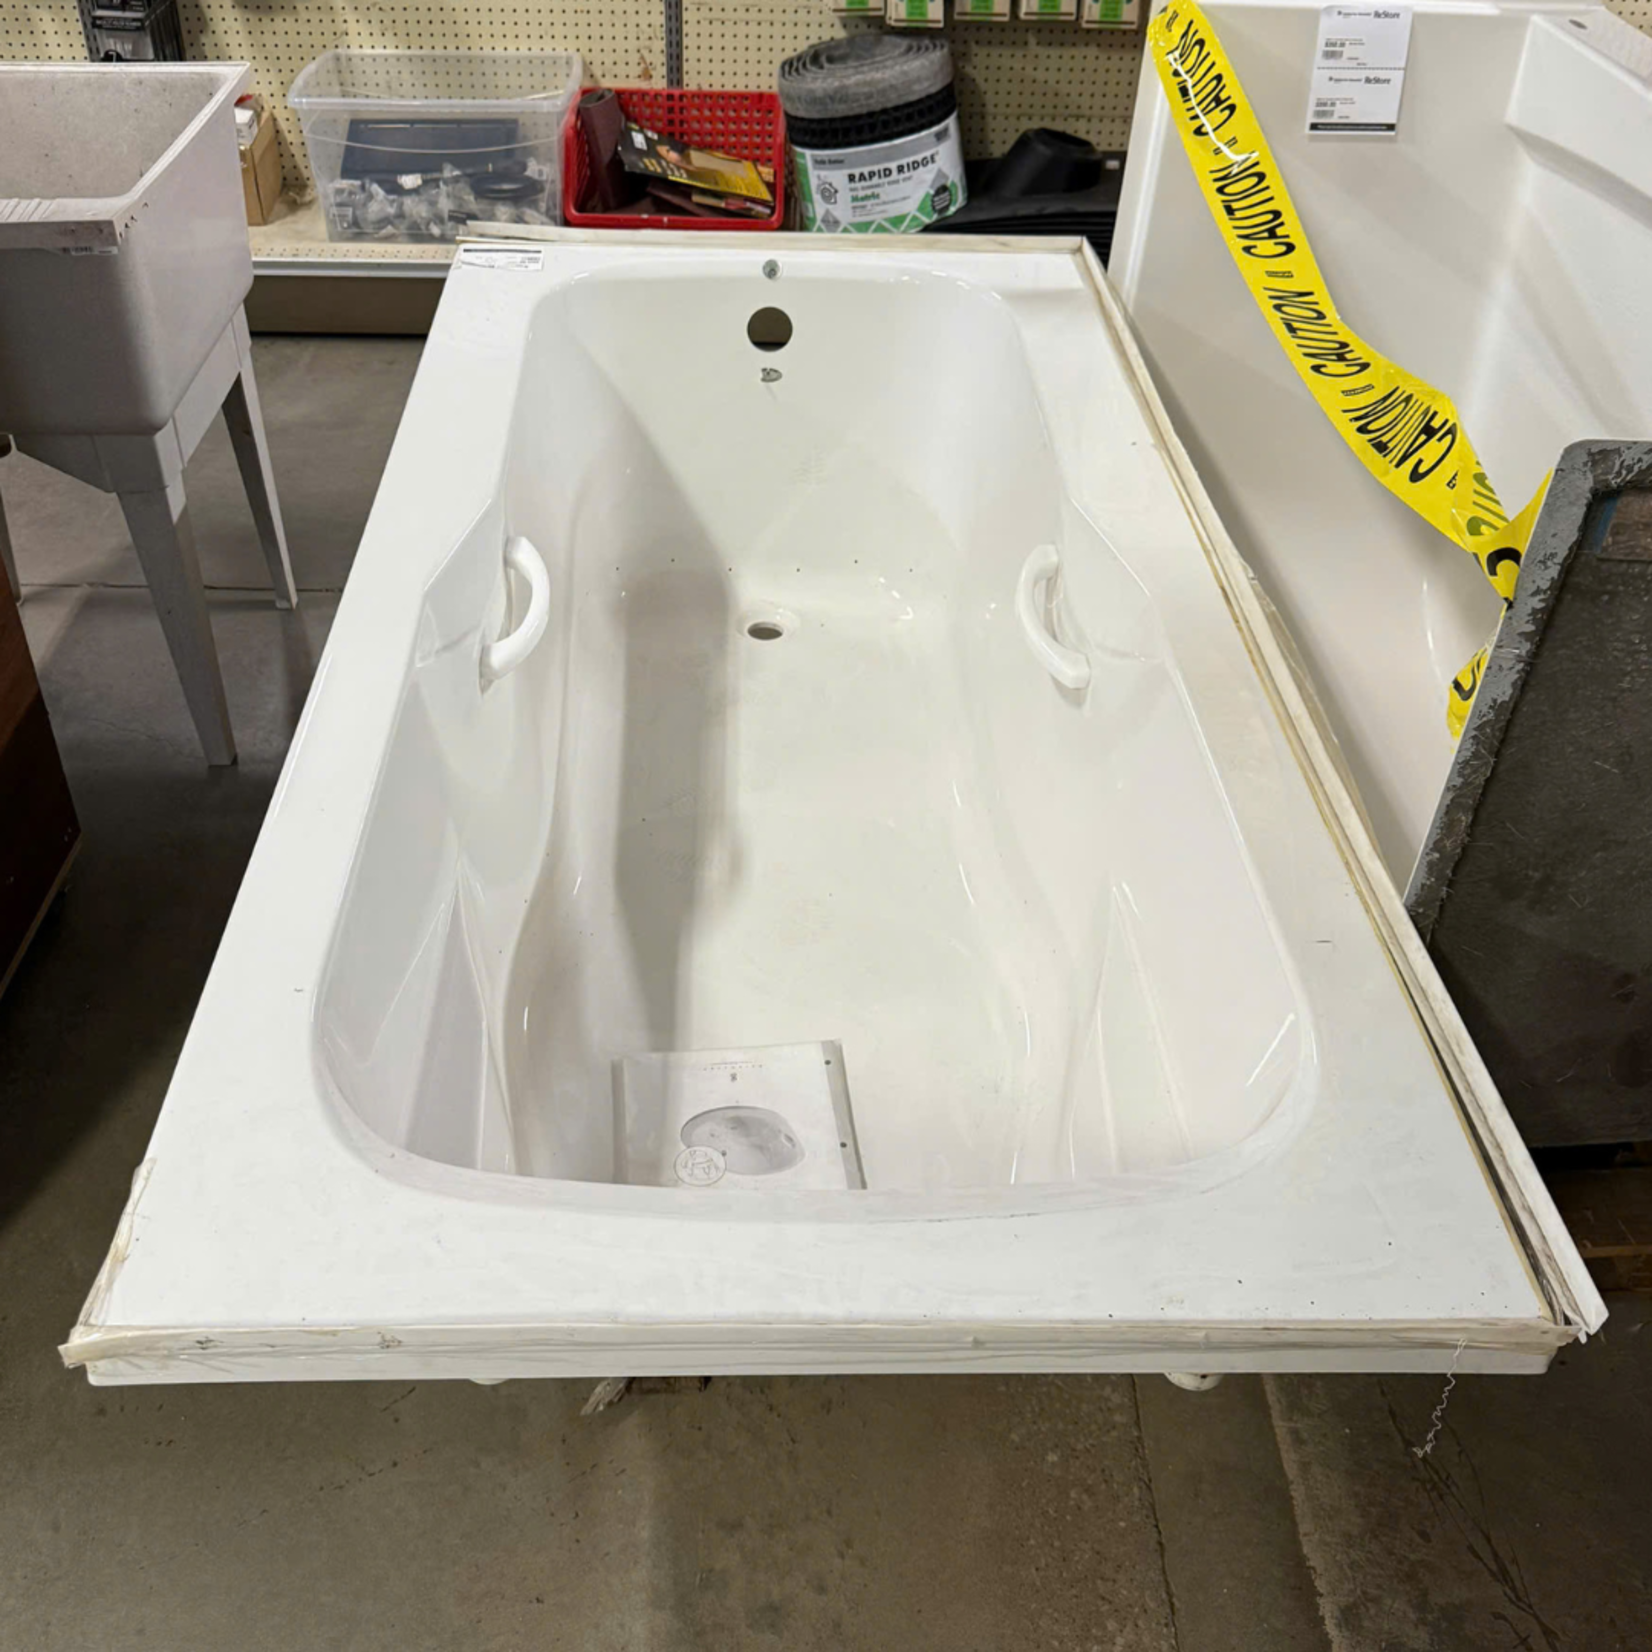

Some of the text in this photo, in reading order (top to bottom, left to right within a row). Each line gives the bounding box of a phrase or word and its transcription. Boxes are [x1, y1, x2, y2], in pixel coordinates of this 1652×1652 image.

[1166, 19, 1237, 137] CAUTION
[848, 167, 893, 184] RAPID
[896, 154, 937, 175] RIDGE
[1209, 152, 1297, 258] CAUTION
[1262, 286, 1371, 378] CAUTION
[1341, 385, 1458, 484] CAUTION
